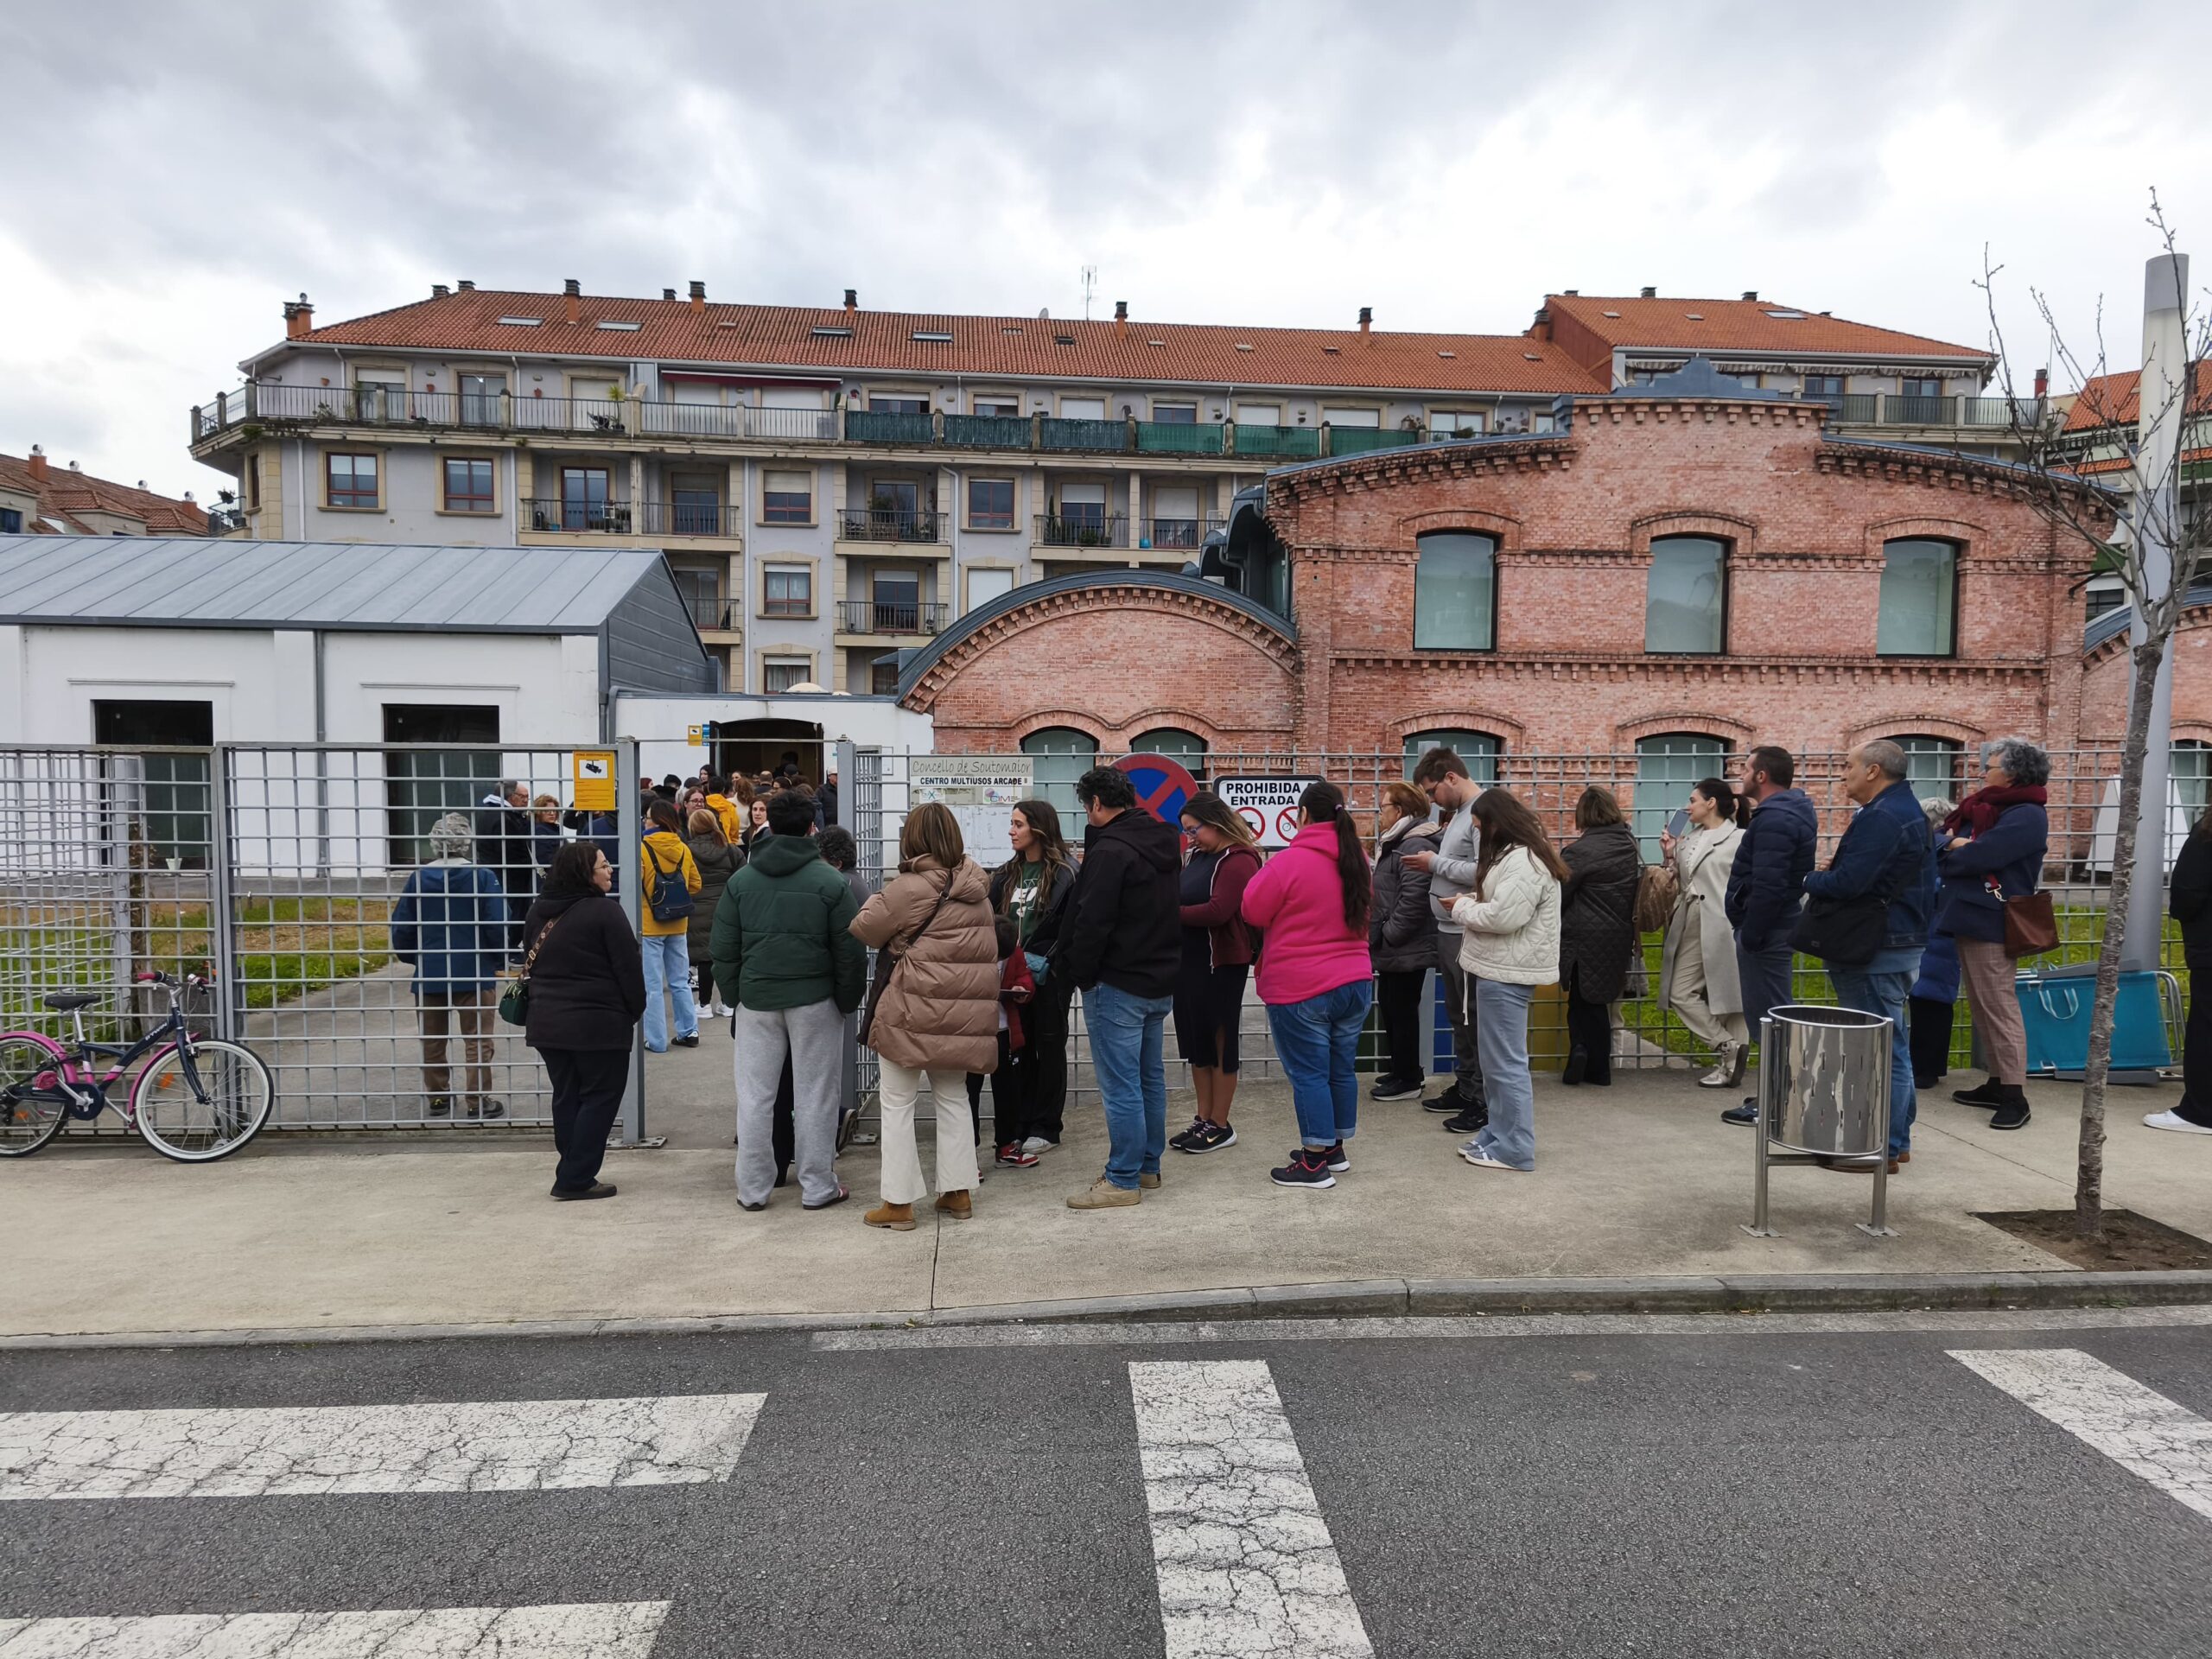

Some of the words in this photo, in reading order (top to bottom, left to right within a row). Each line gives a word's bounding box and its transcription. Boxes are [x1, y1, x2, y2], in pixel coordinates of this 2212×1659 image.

[912, 759, 955, 773] Concello
[957, 759, 969, 773] de
[970, 759, 1031, 773] Soutomaior
[994, 777, 1022, 785] ARCADE
[1226, 783, 1300, 794] PROHIBIDA
[1230, 796, 1294, 805] ENTRADA
